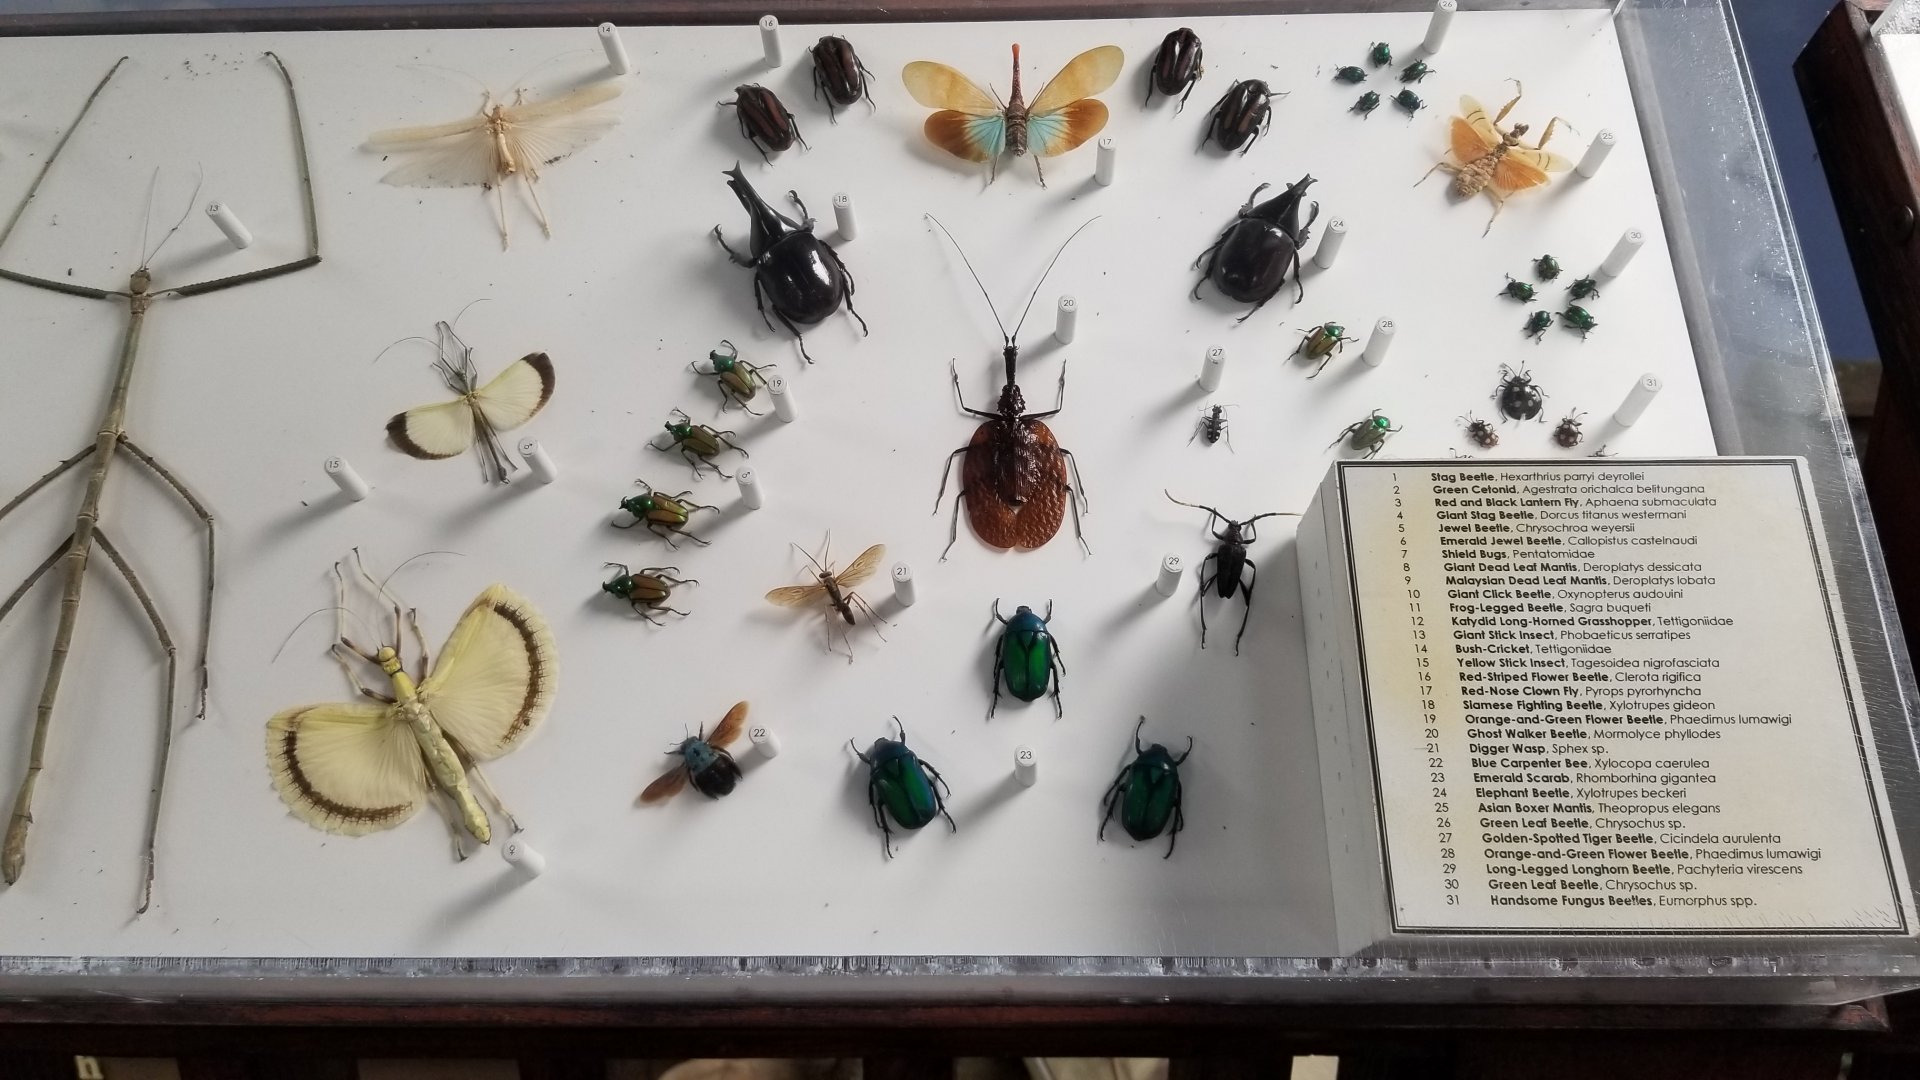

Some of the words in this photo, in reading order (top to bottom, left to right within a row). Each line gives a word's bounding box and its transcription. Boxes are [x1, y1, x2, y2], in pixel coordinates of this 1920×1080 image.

[209, 204, 219, 212] 13
[1630, 231, 1642, 239] 30
[1063, 299, 1074, 307] 20
[1382, 320, 1393, 328] 28
[1212, 348, 1223, 356] 27
[1647, 378, 1657, 387] 31
[330, 460, 339, 468] 15
[1393, 473, 1396, 481] 1
[1431, 473, 1456, 483] Stag
[1459, 472, 1498, 482] Beetle,
[1501, 472, 1561, 481] Hexarthrius
[1564, 472, 1594, 482] parryi
[1598, 472, 1644, 482] deyrollei
[1393, 485, 1400, 494] 2
[1433, 486, 1468, 494] Green
[1472, 485, 1520, 496] Cetonid,
[1522, 485, 1577, 496] Agestrata
[1580, 484, 1634, 493] orichalca
[1637, 484, 1704, 495] belitungana
[1397, 511, 1403, 519] 4
[1436, 510, 1468, 520] Giant
[1470, 511, 1496, 521] Stag
[1499, 510, 1537, 520] Beetle,
[1540, 510, 1579, 519] Dorcus
[1582, 510, 1619, 519] titanus
[1622, 510, 1686, 519] westermani
[1398, 524, 1405, 532] 5
[1438, 524, 1471, 532] Jewel
[1474, 523, 1513, 533] Beetle,
[1516, 523, 1588, 534] Chrysochroa
[1591, 523, 1635, 534] weyersii
[1400, 537, 1406, 545] 6
[1440, 536, 1487, 545] Emerald
[1490, 536, 1523, 546] Jewel
[1526, 536, 1565, 546] Beetle,
[1568, 536, 1628, 547] Callopistus
[1631, 536, 1697, 545] castelnaudi
[1401, 550, 1408, 558] 7
[1442, 549, 1476, 558] Shield
[1480, 550, 1510, 560] Bugs,
[1513, 549, 1595, 558] Pentatomidae
[1169, 557, 1179, 565] 29
[896, 567, 907, 575] 21
[1405, 576, 1411, 585] 9
[1446, 576, 1506, 587] Malaysian
[1508, 576, 1540, 585] Dead
[1543, 576, 1566, 585] Leaf
[1570, 576, 1610, 585] Mantis,
[1613, 575, 1674, 587] Deroplatys
[1677, 576, 1715, 585] lobata
[1408, 590, 1420, 598] 10
[1448, 589, 1479, 600] Giant
[1482, 589, 1513, 598] Click
[1515, 589, 1554, 599] Beetle,
[1558, 589, 1630, 600] Oxynopterus
[1633, 589, 1683, 598] audouini
[1410, 603, 1420, 612] 11
[1450, 603, 1524, 614] Frog-Legged
[1527, 603, 1566, 613] Beetle,
[1570, 603, 1603, 614] Sagra
[1607, 602, 1651, 614] buqueti
[1413, 630, 1426, 639] 13
[1453, 630, 1485, 639] Giant
[1488, 630, 1517, 639] Stick
[1519, 630, 1557, 640] Insect,
[1560, 630, 1633, 641] Phobaeticus
[1636, 630, 1691, 642] serratipes
[1415, 644, 1428, 653] 14
[1455, 644, 1533, 654] Bush-Cricket,
[1535, 644, 1613, 656] Tettigoniidae
[1416, 658, 1429, 667] 15
[1456, 658, 1496, 669] Yellow
[1499, 658, 1528, 669] Stick
[1530, 658, 1568, 668] Insect,
[1571, 658, 1640, 670] Tagesoidea
[1643, 658, 1720, 670] nigrofasciata
[1420, 686, 1432, 695] 17
[1461, 686, 1520, 696] Red-Nose
[1522, 686, 1560, 696] Clown
[1563, 686, 1582, 698] Fly,
[1586, 686, 1624, 698] Pyrops
[1627, 686, 1701, 698] pyrorhyncha
[1422, 700, 1435, 710] 18
[1463, 700, 1513, 710] Siamese
[1516, 700, 1563, 712] Fighting
[1566, 700, 1607, 711] Beetle,
[1609, 700, 1670, 712] Xylotrupes
[1673, 700, 1716, 712] gideon
[1424, 714, 1436, 724] 19
[1465, 714, 1582, 726] Orange-and-Green
[1584, 714, 1623, 724] Flower
[1626, 714, 1667, 725] Beetle,
[1670, 714, 1736, 724] Phaedimus
[1739, 714, 1792, 726] lumawigi
[754, 728, 765, 737] 22
[1020, 750, 1032, 760] 23
[1427, 743, 1439, 753] 21
[1469, 743, 1510, 756] Digger
[1512, 743, 1549, 756] Wasp,
[1552, 744, 1588, 756] Sphex
[1590, 746, 1608, 756] sp.
[1428, 758, 1444, 768] 22
[1472, 758, 1497, 768] Blue
[1500, 758, 1561, 770] Carpenter
[1565, 758, 1591, 768] Bee,
[1594, 758, 1652, 770] Xylocopa
[1655, 758, 1710, 768] caerulea
[1431, 772, 1445, 782] 23
[1474, 772, 1523, 783] Emerald
[1526, 772, 1573, 784] Scarab,
[1576, 773, 1657, 783] Rhomborhina
[1660, 772, 1716, 785] gigantea
[1434, 802, 1449, 812] 25
[1478, 802, 1512, 814] Asian
[1515, 803, 1549, 813] Boxer
[1553, 803, 1594, 814] Mantis,
[1598, 803, 1669, 815] Theopropus
[1672, 802, 1720, 815] elegans
[1436, 817, 1451, 828] 26
[1480, 818, 1518, 829] Green
[1522, 818, 1547, 828] Leaf
[1550, 818, 1592, 829] Beetle,
[1595, 818, 1665, 830] Chrysochus
[1668, 820, 1685, 830] sp.
[1439, 833, 1452, 843] 27
[1482, 833, 1580, 846] Golden-Spotted
[1582, 833, 1612, 846] Tiger
[1615, 833, 1657, 844] Beetle,
[1660, 833, 1719, 844] Cicindela
[1722, 833, 1781, 844] aurulenta
[1443, 863, 1456, 874] 29
[1486, 864, 1568, 876] Long-Legged
[1572, 864, 1629, 876] Longhorn
[1632, 864, 1674, 875] Beetle,
[1678, 864, 1743, 876] Pachyteria
[1746, 864, 1803, 874] virescens
[1446, 895, 1459, 905] 31
[1491, 895, 1558, 906] Handsome
[1562, 895, 1605, 908] Fungus
[1608, 895, 1656, 906] Beetles,
[1659, 895, 1727, 908] Eumorphus
[1730, 897, 1757, 908] spp.
